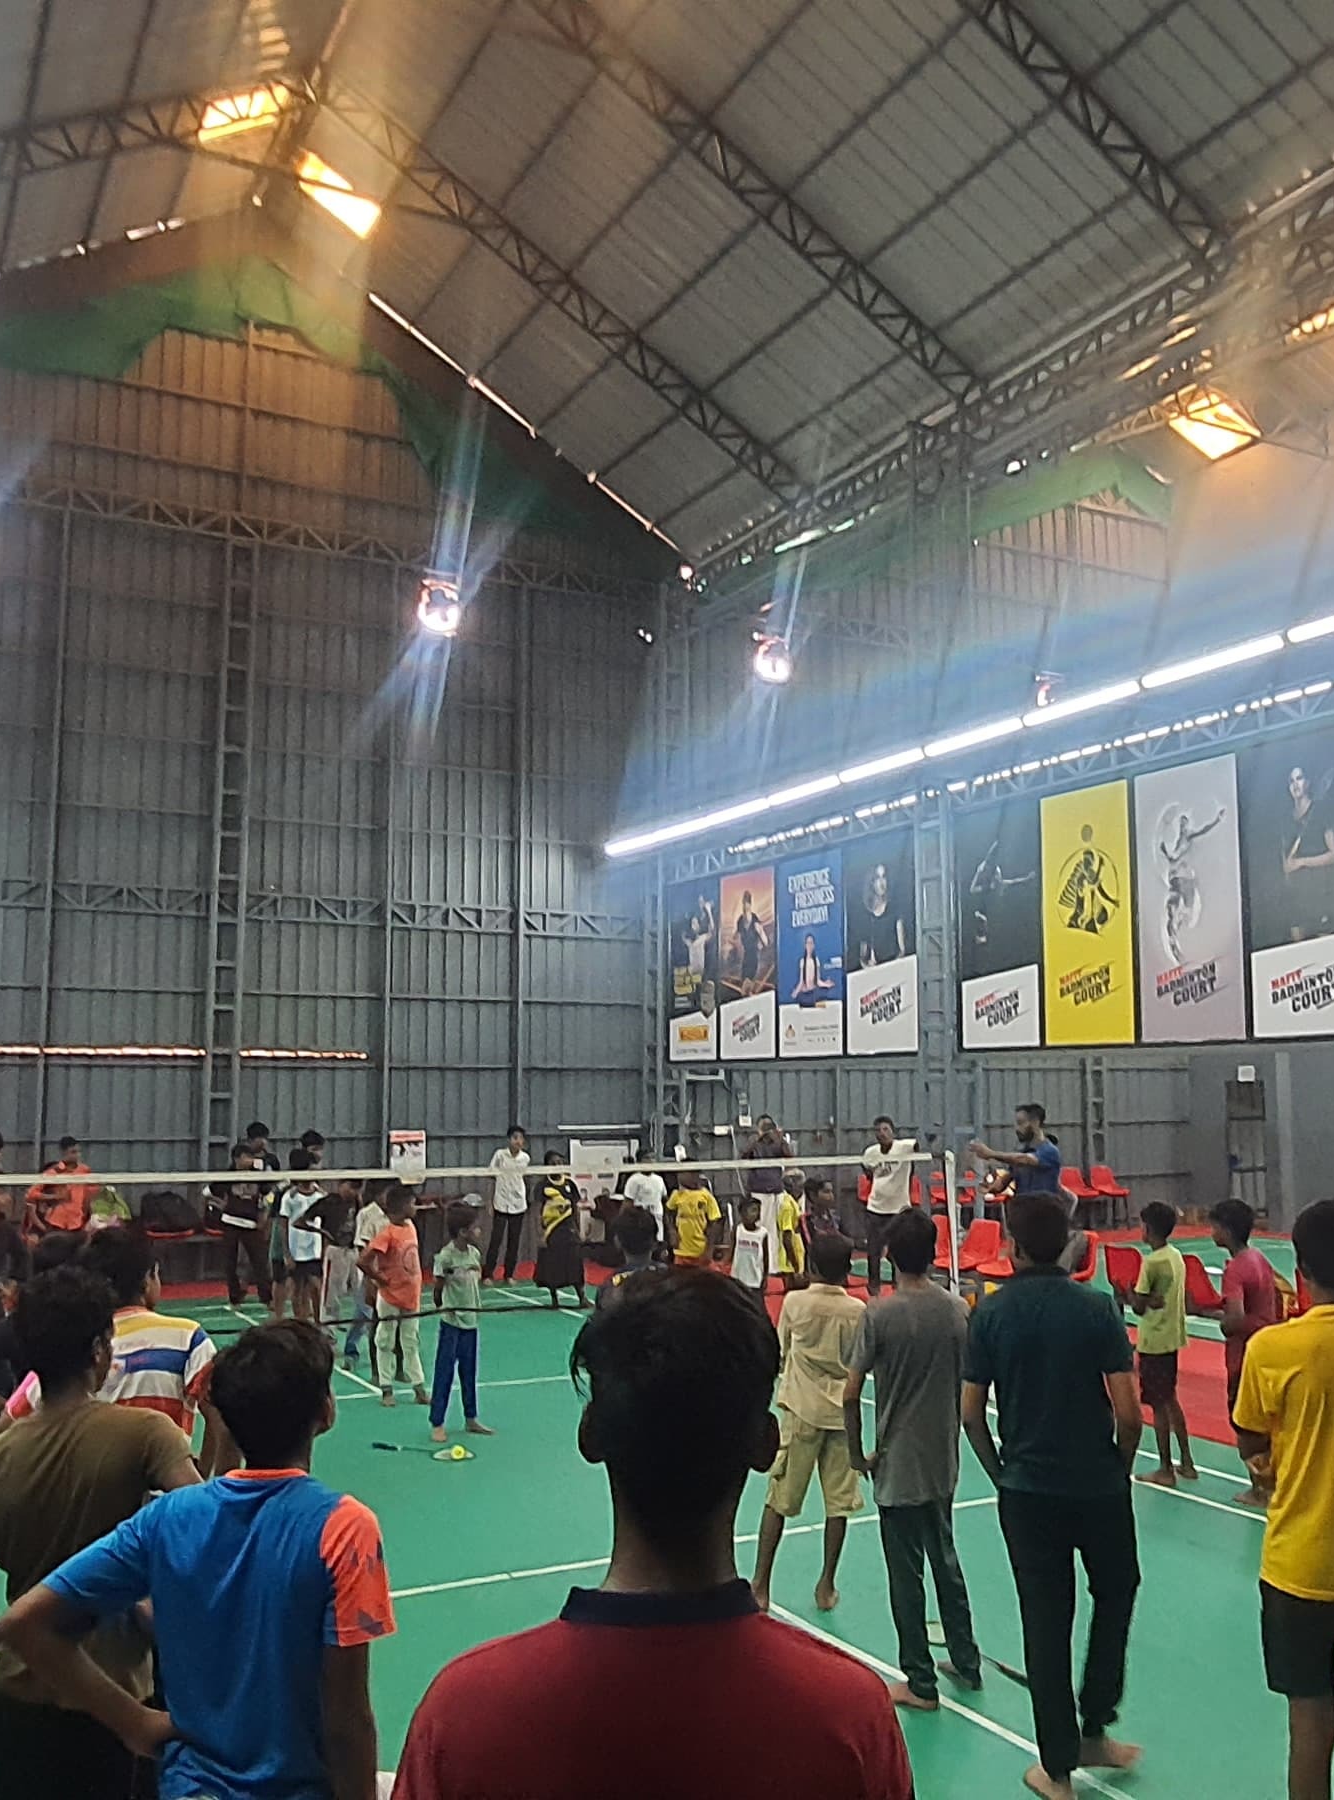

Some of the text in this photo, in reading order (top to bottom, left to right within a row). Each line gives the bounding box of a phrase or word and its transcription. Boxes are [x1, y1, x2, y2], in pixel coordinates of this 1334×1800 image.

[1074, 980, 1110, 1006] COURT
[1157, 961, 1216, 998] BADMINTON
[1173, 976, 1216, 1006] COURT
